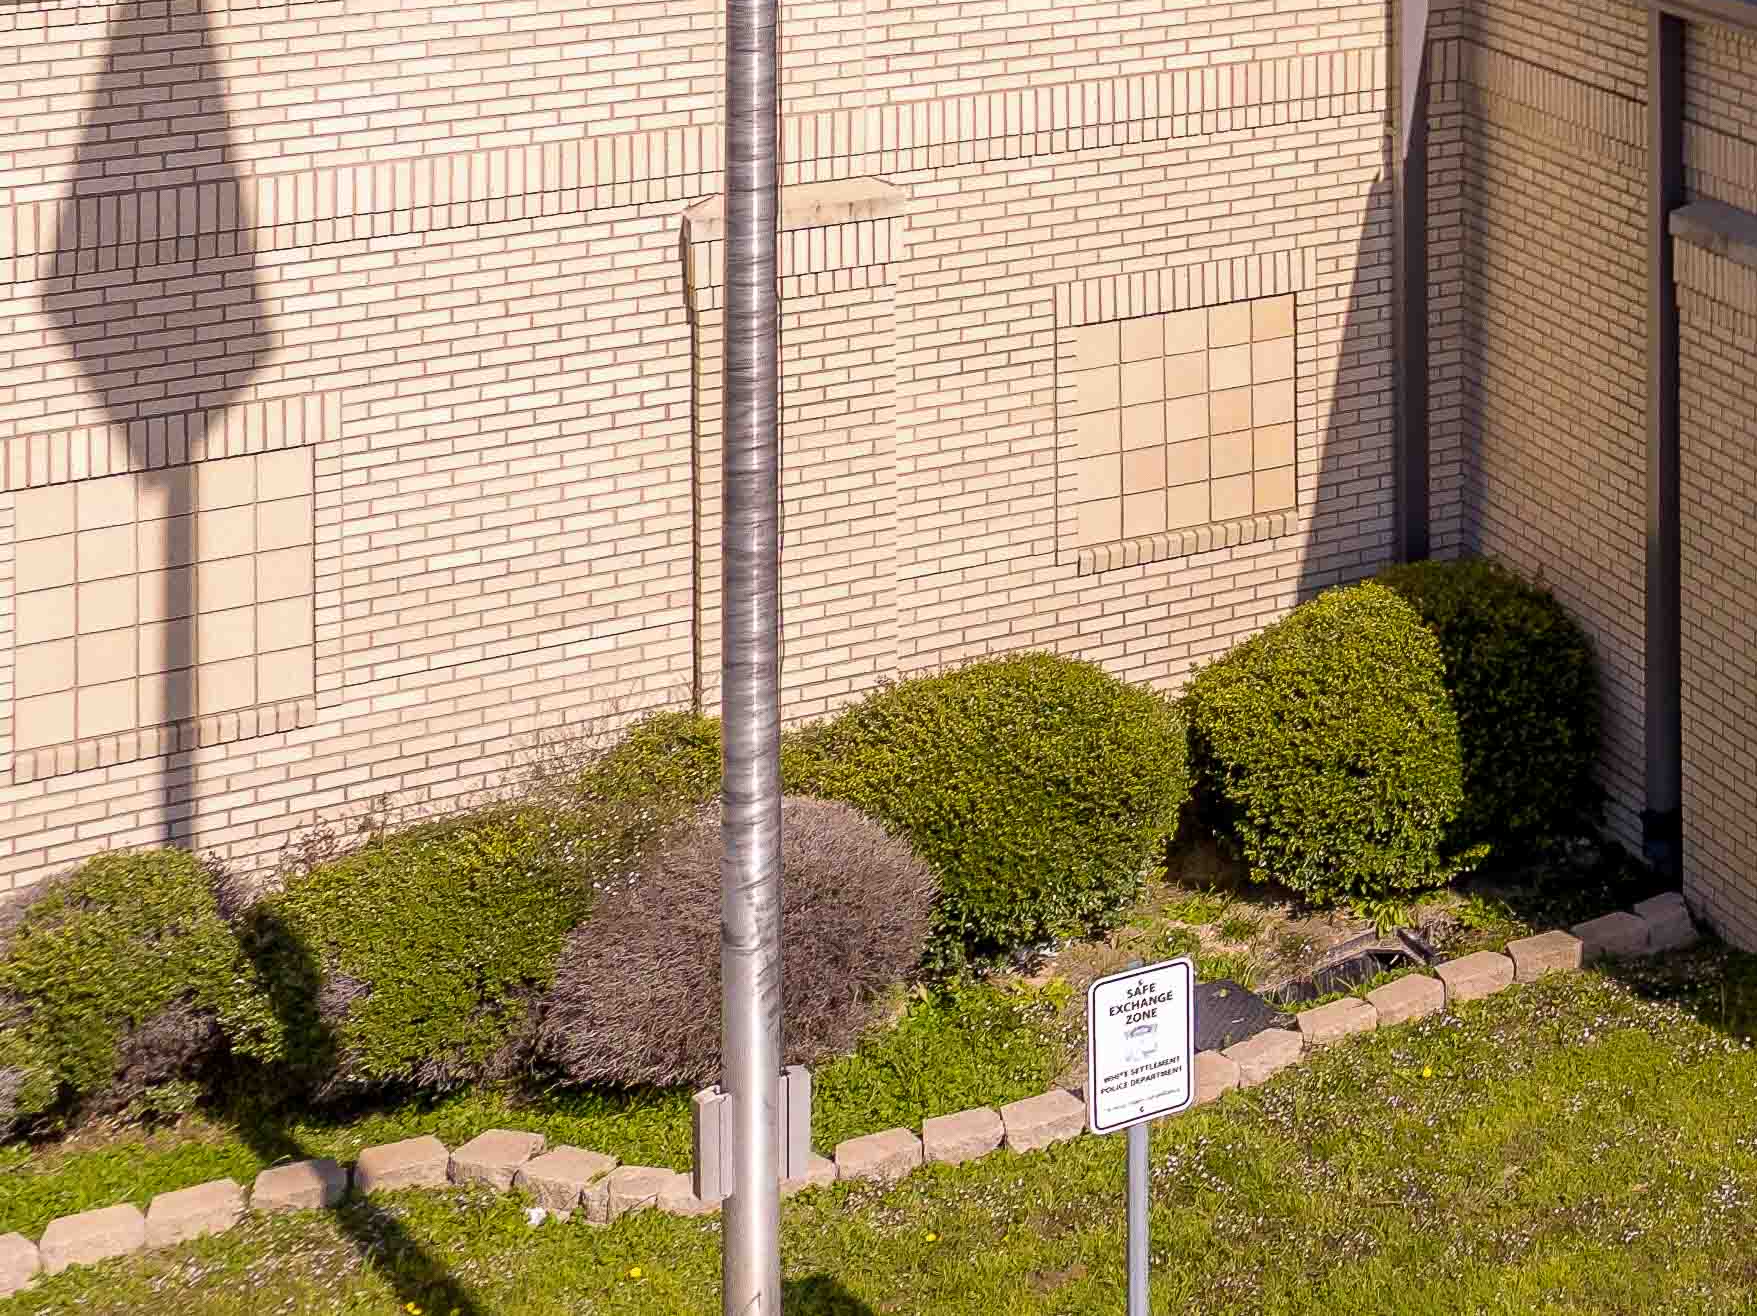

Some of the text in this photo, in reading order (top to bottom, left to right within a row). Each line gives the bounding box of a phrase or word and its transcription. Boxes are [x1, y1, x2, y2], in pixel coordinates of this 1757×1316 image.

[1127, 983, 1156, 999] SAFE
[1109, 990, 1173, 1016] EXCHANGE
[1126, 1008, 1157, 1024] ZONE
[1130, 1056, 1180, 1075] SETTLEMENT
[1100, 1065, 1182, 1095] POLICE DEPARTMENT
